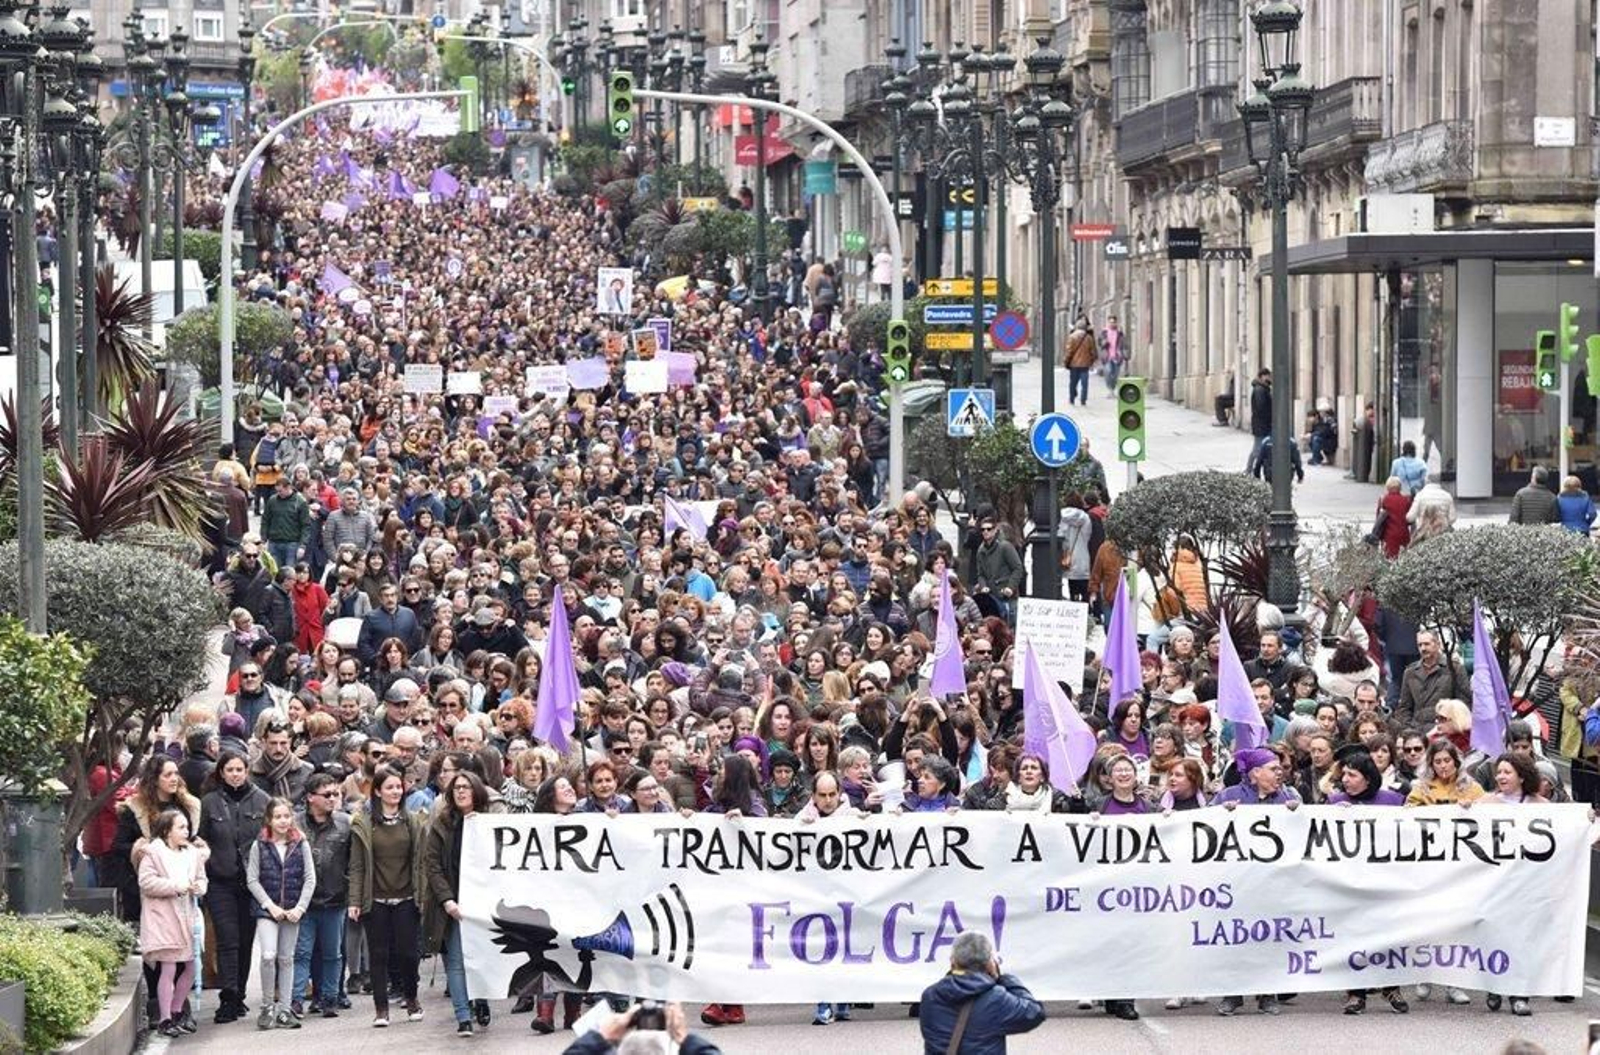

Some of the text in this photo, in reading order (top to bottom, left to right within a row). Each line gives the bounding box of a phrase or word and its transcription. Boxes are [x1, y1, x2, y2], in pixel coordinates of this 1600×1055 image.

[1202, 251, 1247, 259] ZARA
[926, 309, 972, 319] Pontevedra
[490, 815, 1557, 876] PARA TRANSFORMAR A VIDA DAS MULLERES
[1045, 884, 1234, 912] DE COIDADOS
[1193, 917, 1335, 946] LABORAL
[1287, 944, 1510, 976] DE CONSUMO
